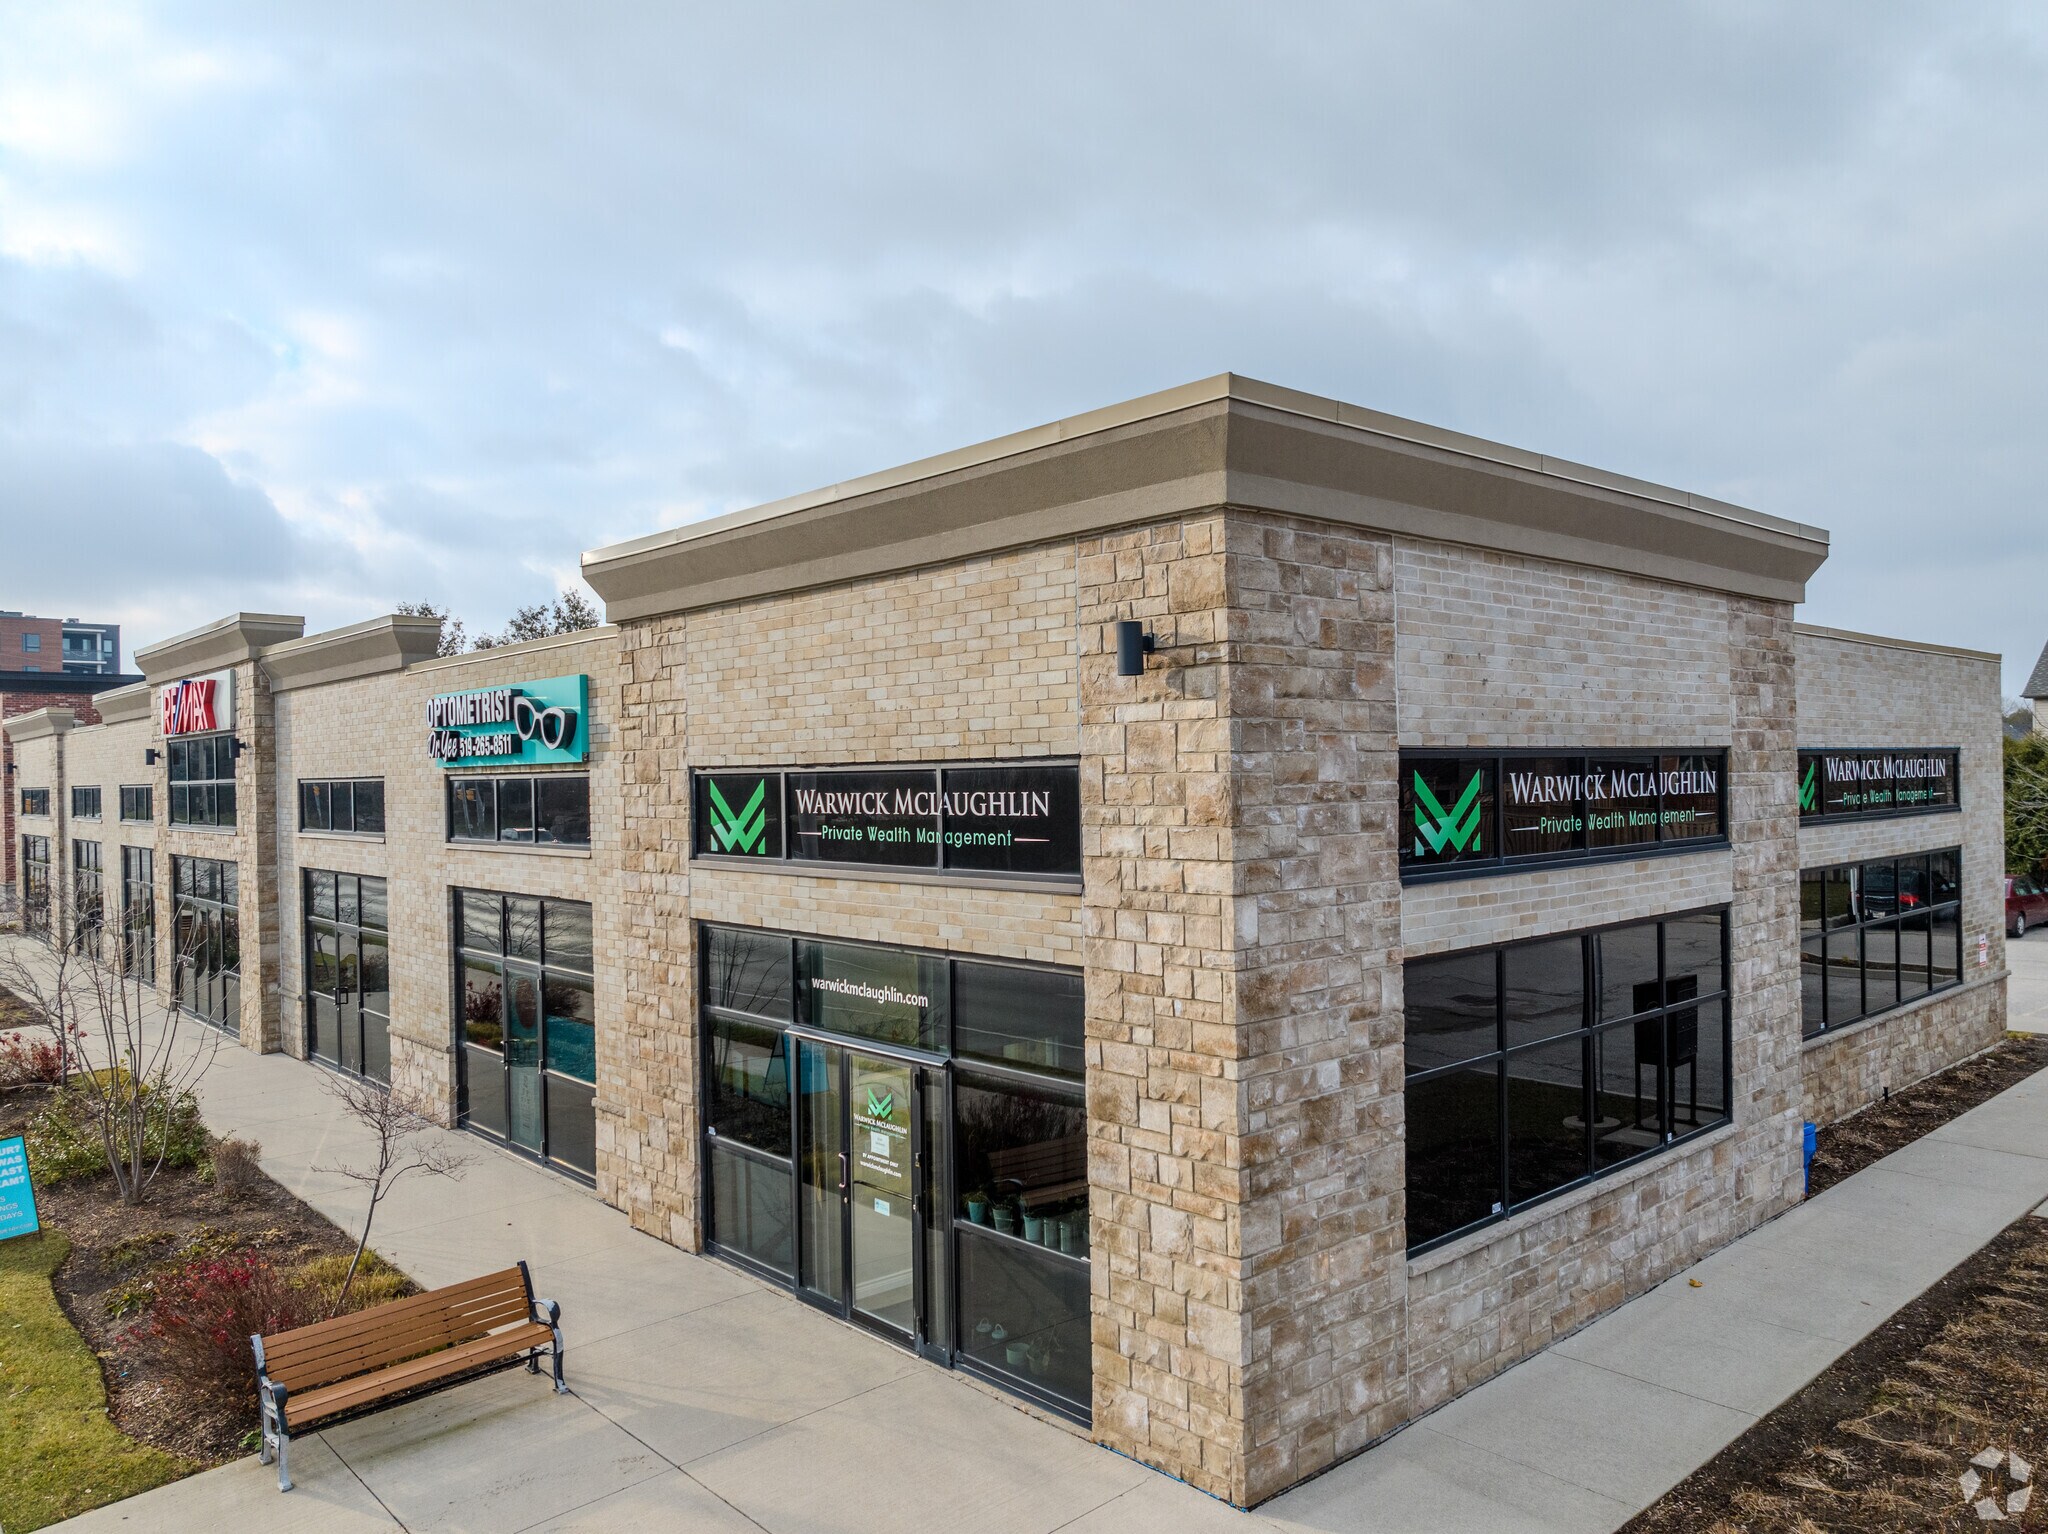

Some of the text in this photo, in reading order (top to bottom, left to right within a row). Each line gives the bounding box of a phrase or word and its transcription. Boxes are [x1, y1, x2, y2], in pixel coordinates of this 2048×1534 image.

[426, 688, 512, 728] OPTOMETRIST
[459, 734, 512, 758] 519-265-8511
[1825, 757, 1882, 782] WARWICK
[1509, 772, 1608, 804] WARWICK
[1843, 792, 1868, 806] Privae
[795, 789, 891, 815] WARWICK
[1540, 806, 1695, 834] Private Wealth Manaement
[822, 825, 1012, 848] Private Wealth Management
[812, 977, 929, 1008] warwickmclaughlin.com
